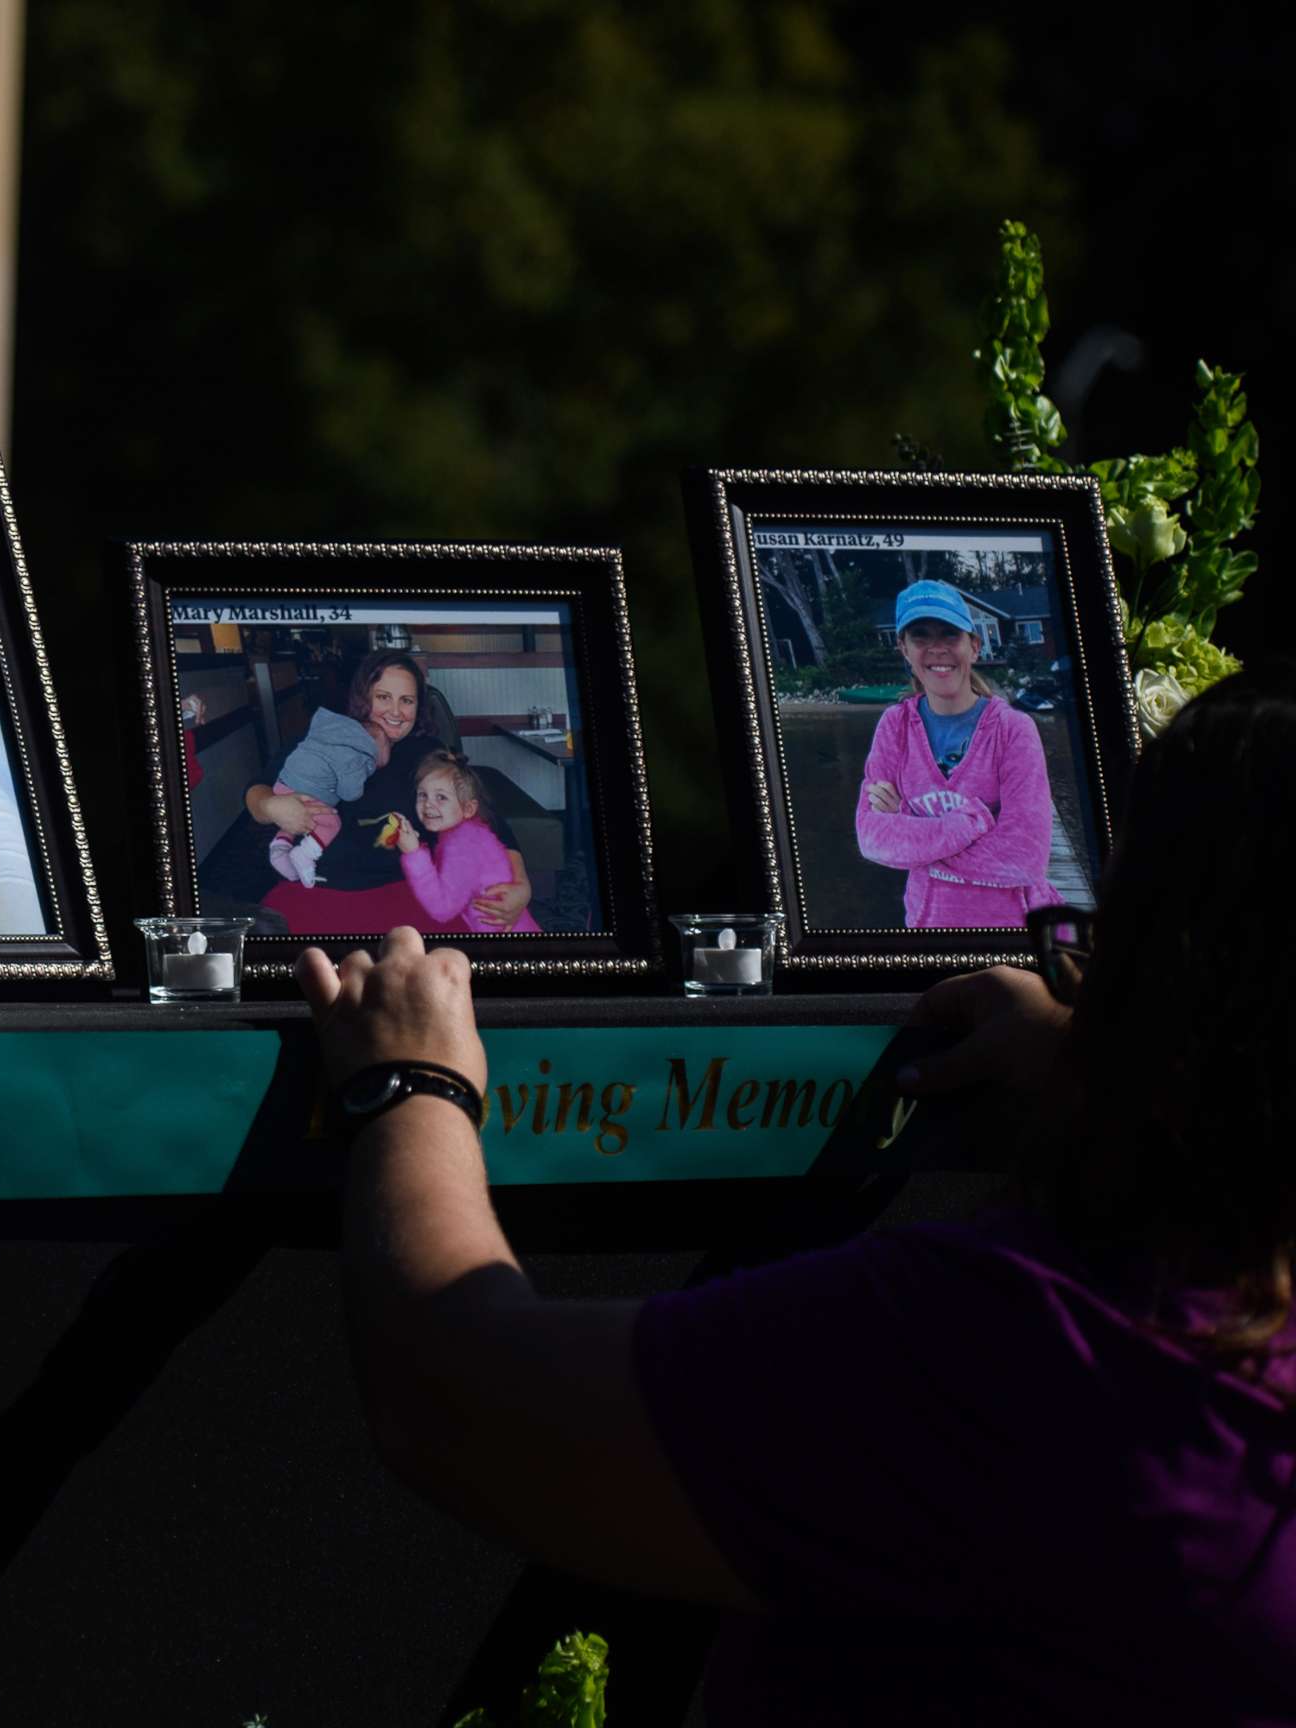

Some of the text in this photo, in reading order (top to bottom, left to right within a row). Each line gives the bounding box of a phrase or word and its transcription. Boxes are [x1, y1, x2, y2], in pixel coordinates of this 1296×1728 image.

[755, 532, 905, 549] usan Karnatz, 49
[173, 604, 353, 624] Mary Marshall, 34
[481, 1056, 919, 1157] ving Memoy
